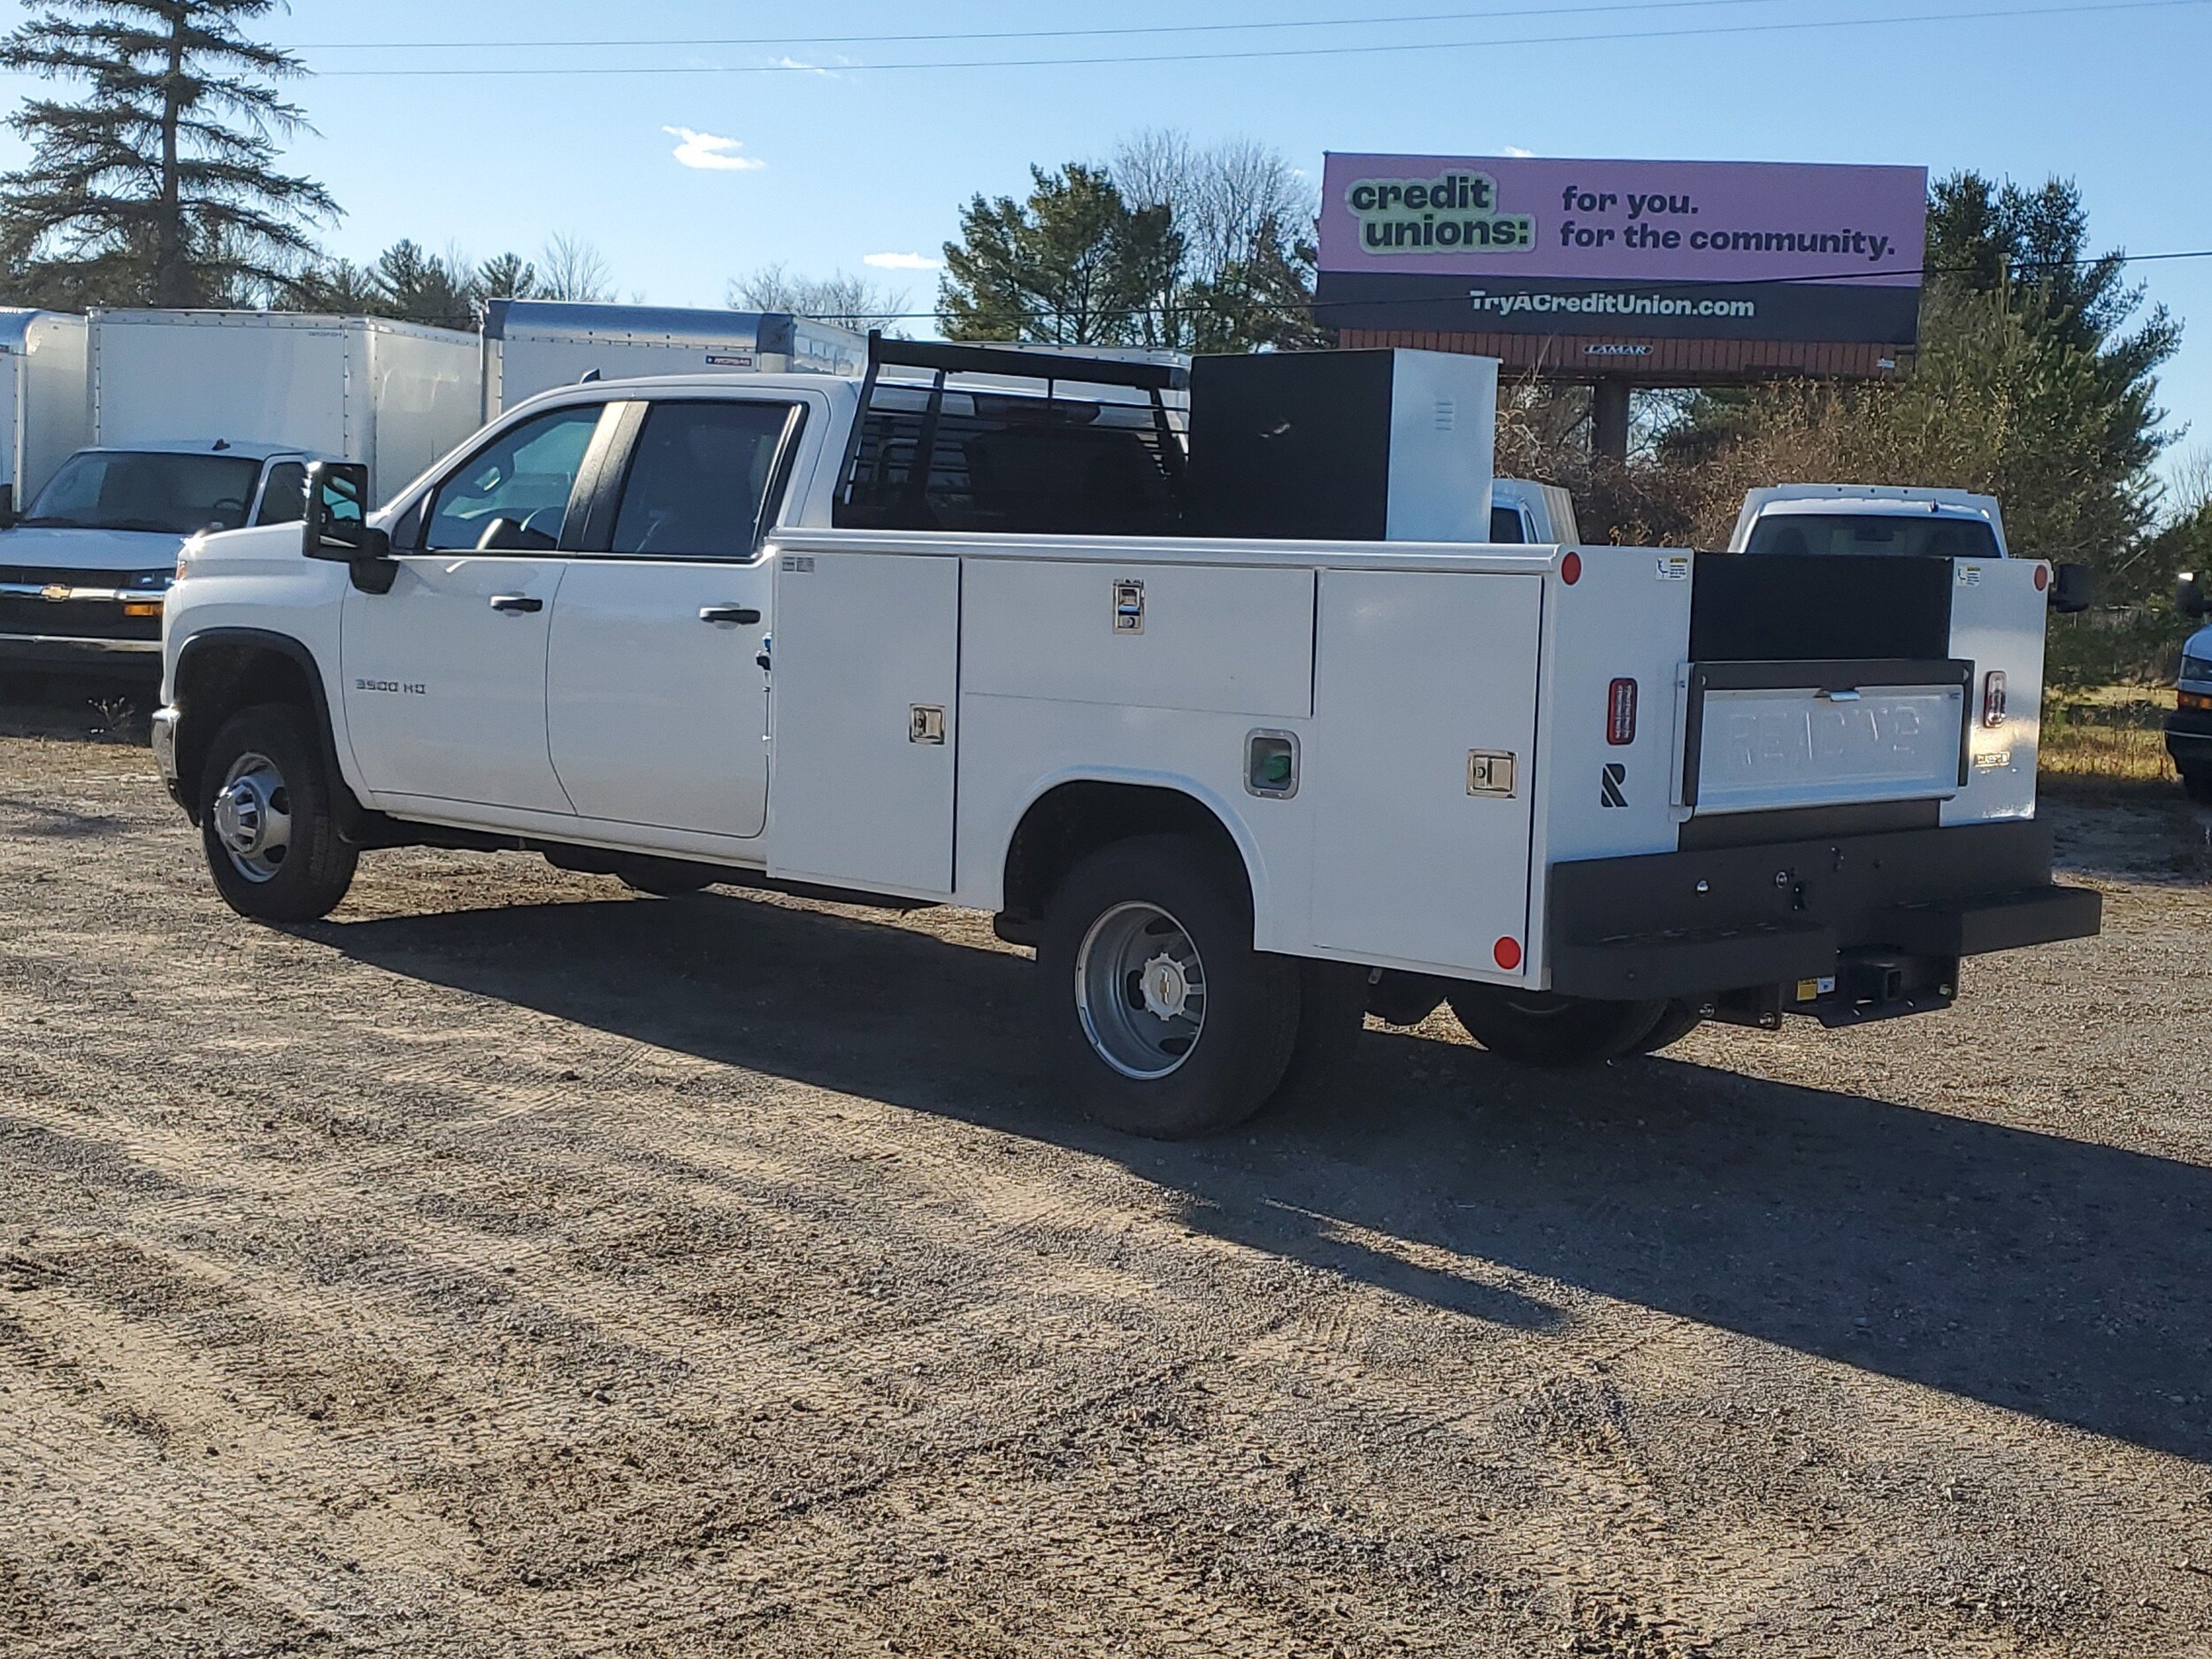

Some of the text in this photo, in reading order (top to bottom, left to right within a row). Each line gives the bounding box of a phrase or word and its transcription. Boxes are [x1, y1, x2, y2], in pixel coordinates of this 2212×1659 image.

[1352, 175, 1490, 211] credit
[1562, 185, 1699, 219] for you.
[1365, 213, 1529, 247] unions:
[1560, 220, 1895, 262] for the community.
[1469, 289, 1755, 317] TryACreditUnion.com
[1588, 344, 1647, 355] LAMAR
[356, 679, 426, 694] 3500 HD
